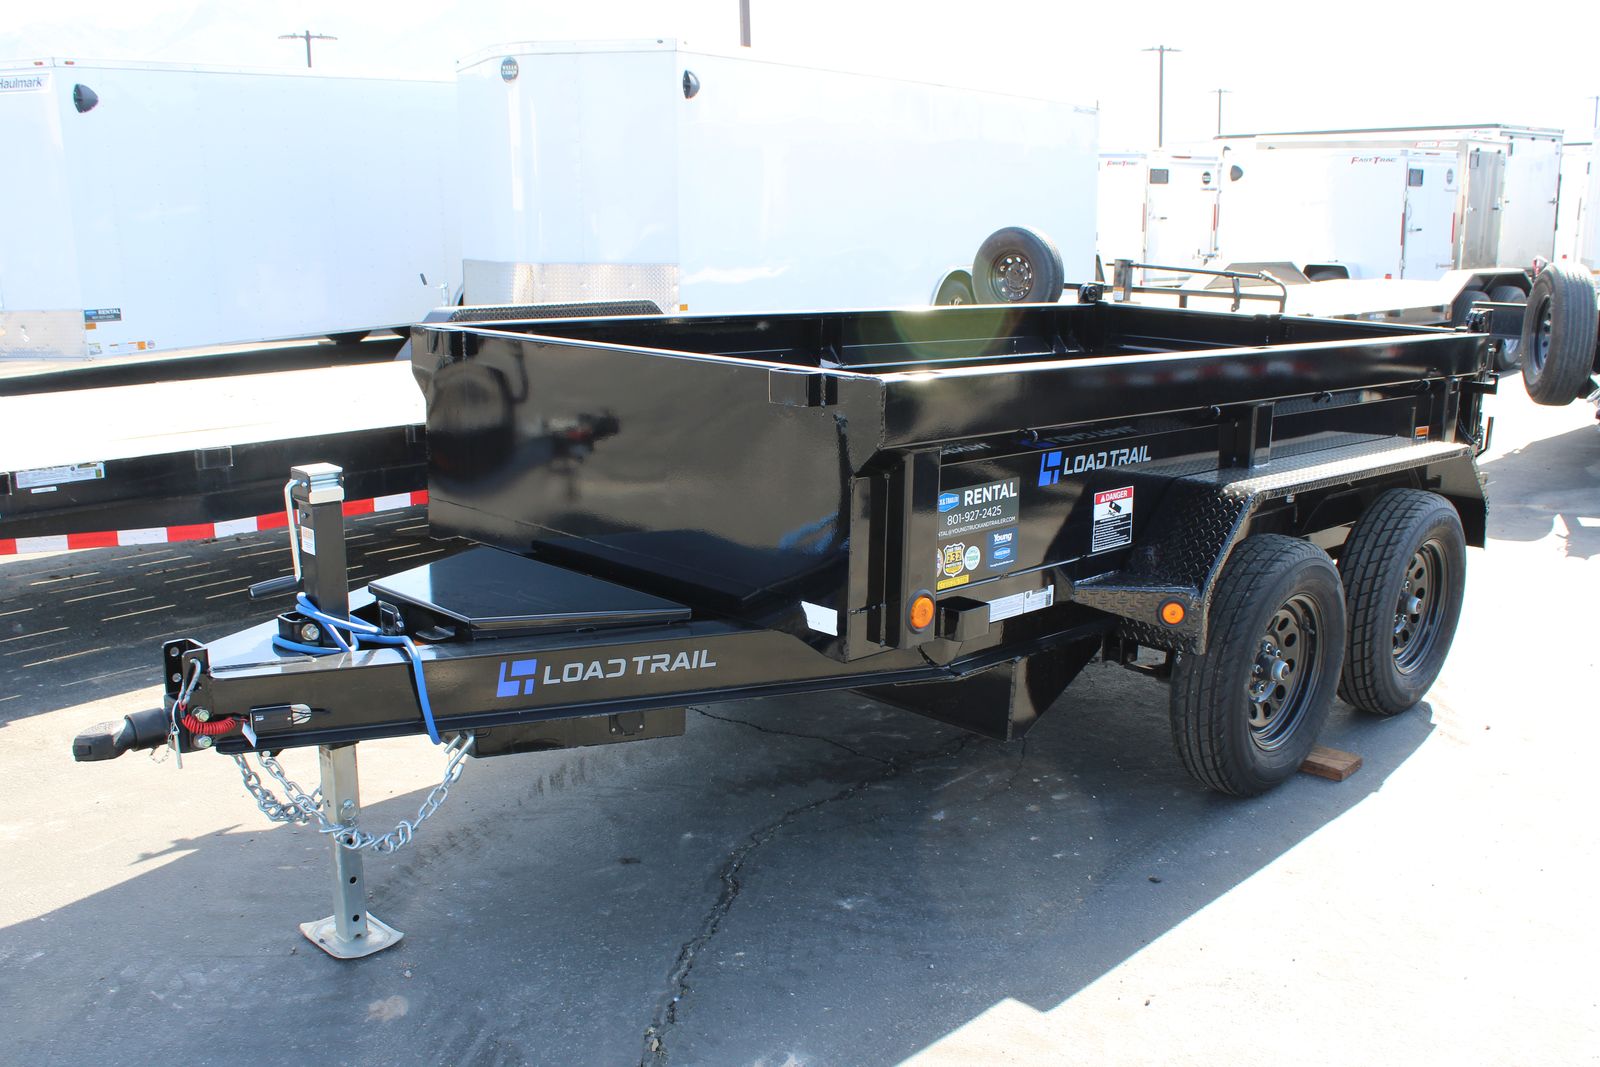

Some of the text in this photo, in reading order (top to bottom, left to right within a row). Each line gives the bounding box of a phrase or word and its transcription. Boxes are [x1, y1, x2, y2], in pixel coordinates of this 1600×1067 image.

[1063, 445, 1152, 475] LOAD TRAIL
[964, 482, 1017, 507] RENTAL
[1106, 490, 1128, 502] DANGER
[947, 505, 1002, 526] 801-927-2425
[994, 532, 1013, 543] Young
[543, 649, 717, 685] LOAD TRAIL
